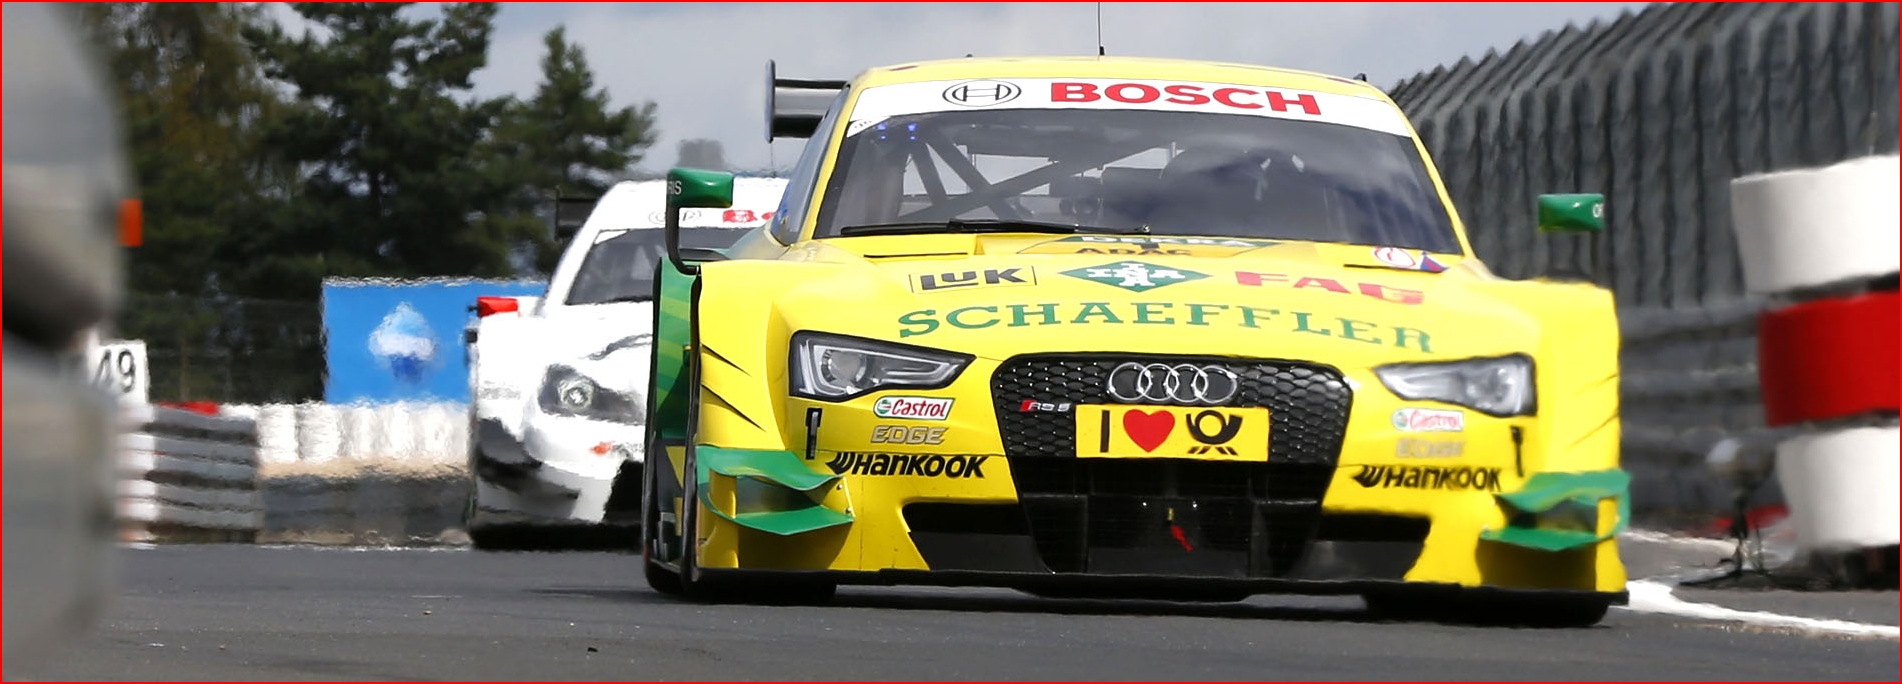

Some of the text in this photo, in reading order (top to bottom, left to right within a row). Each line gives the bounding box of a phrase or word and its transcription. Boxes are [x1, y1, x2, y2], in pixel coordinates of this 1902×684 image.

[1051, 82, 1322, 116] BOSCH
[1235, 271, 1425, 305] FAG
[898, 302, 1434, 354] SCHAEFFLER
[891, 398, 949, 418] Castrol
[870, 425, 949, 445] EDGE
[1100, 410, 1110, 453] I
